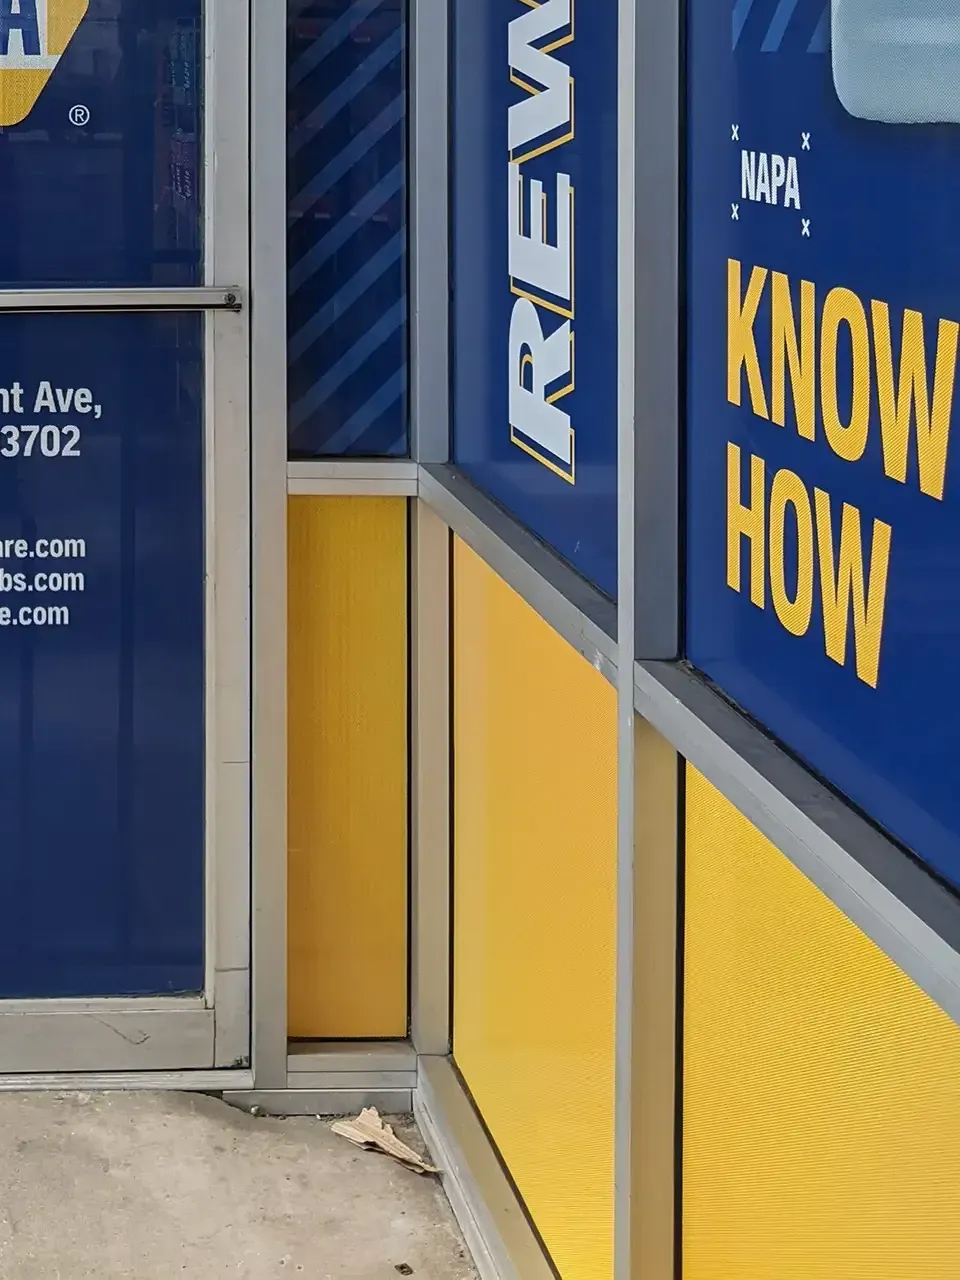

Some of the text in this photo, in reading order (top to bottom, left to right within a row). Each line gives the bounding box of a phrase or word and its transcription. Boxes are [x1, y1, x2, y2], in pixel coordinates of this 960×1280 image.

[741, 149, 801, 210] NAPA
[33, 381, 102, 419] Ave,
[727, 257, 960, 501] KNOW
[727, 440, 892, 689] HOW
